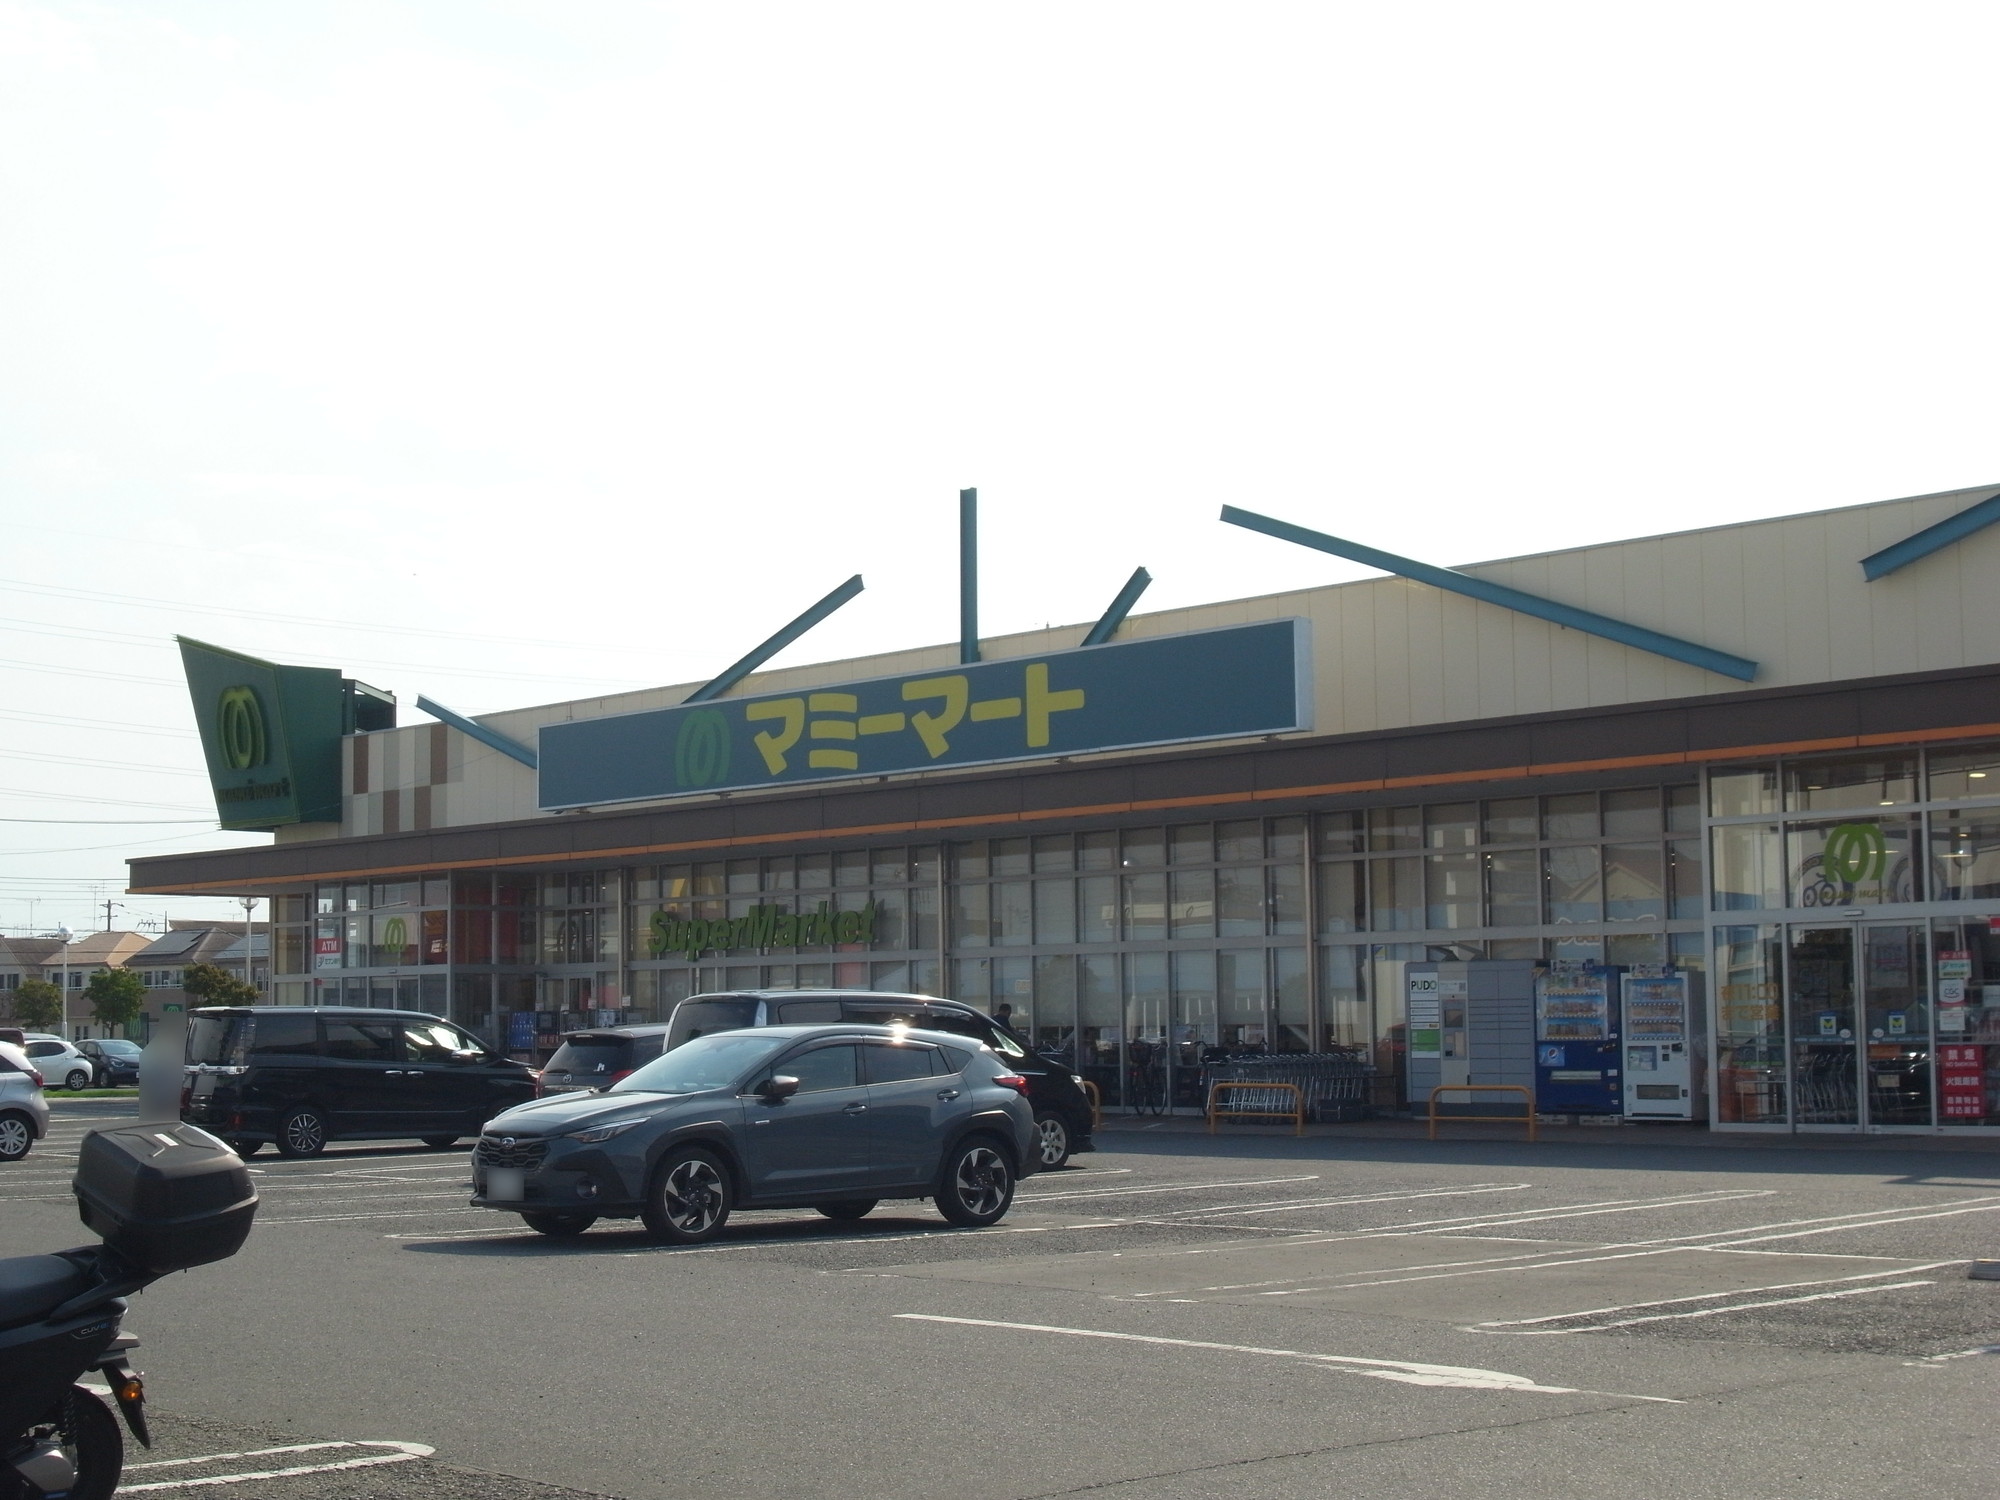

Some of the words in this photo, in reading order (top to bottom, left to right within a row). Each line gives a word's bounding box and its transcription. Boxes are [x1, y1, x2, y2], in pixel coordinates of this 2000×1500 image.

[746, 663, 1086, 775] マミーマート
[322, 940, 337, 952] ATM
[647, 900, 878, 962] SuperMarket
[1411, 980, 1438, 991] PUDO
